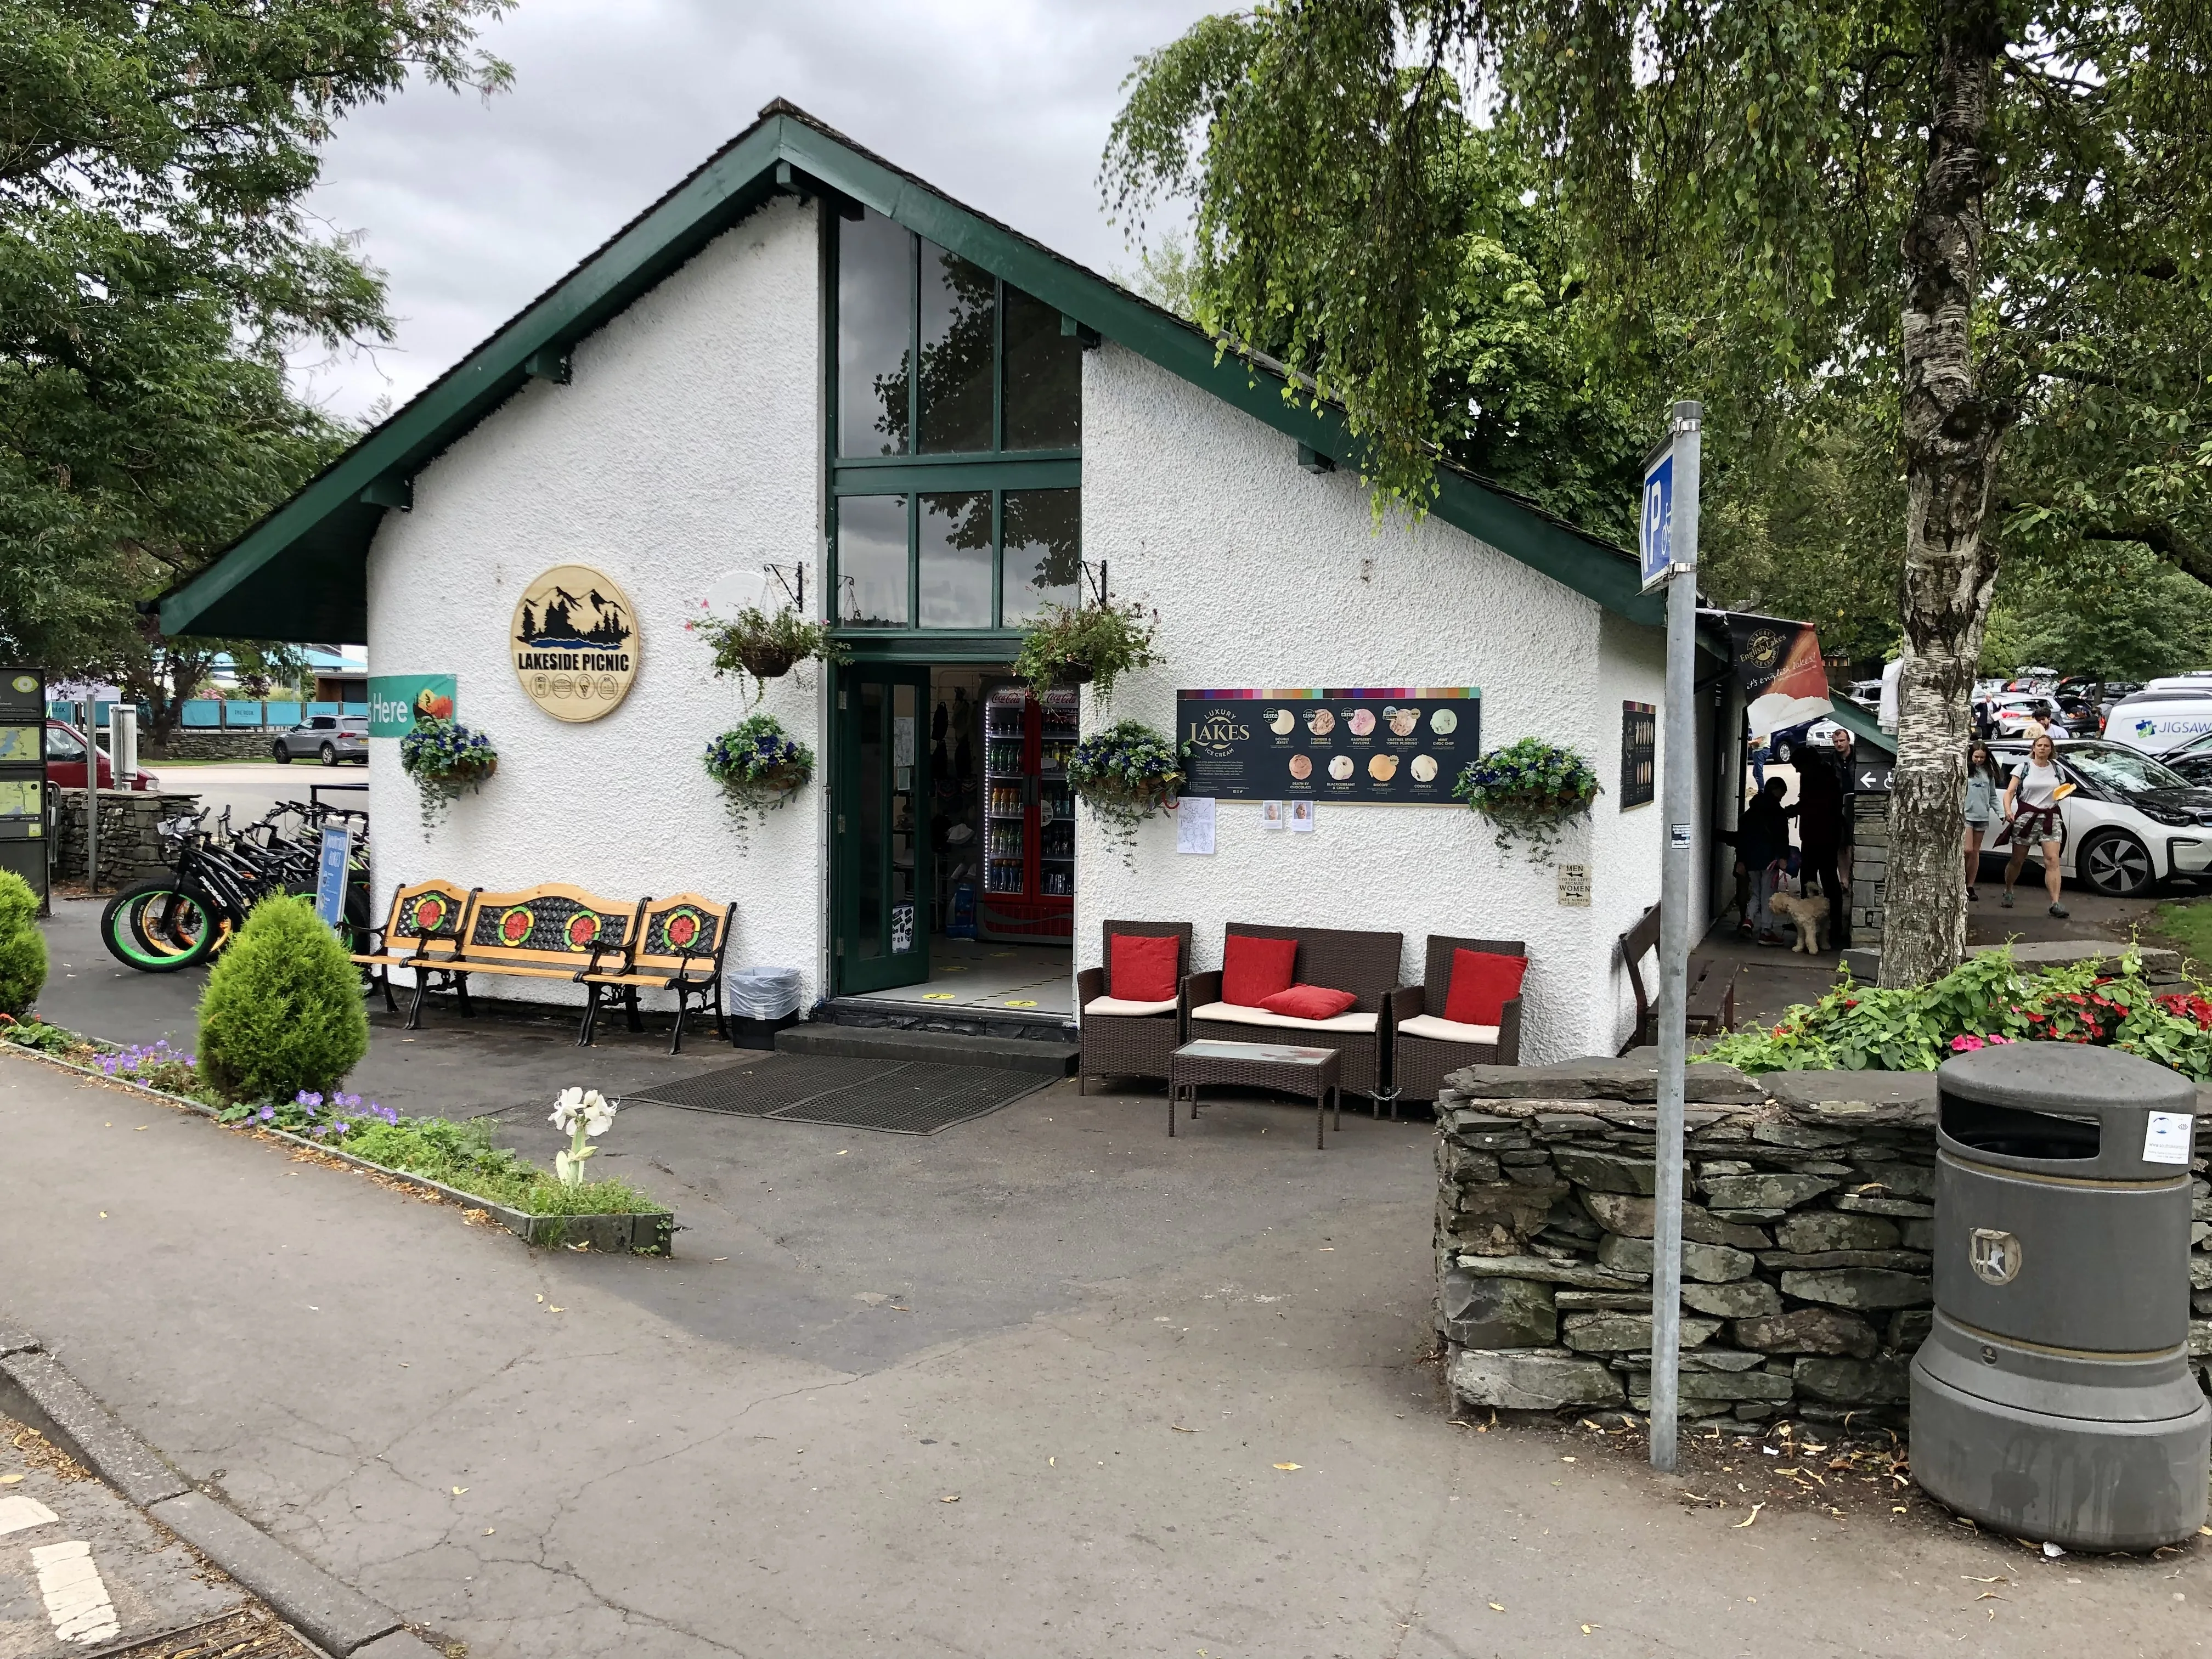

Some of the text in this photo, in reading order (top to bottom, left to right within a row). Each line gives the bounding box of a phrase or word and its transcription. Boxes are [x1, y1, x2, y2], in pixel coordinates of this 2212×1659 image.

[1649, 479, 1661, 565] P
[1749, 630, 1770, 645] LUXURY
[1740, 634, 1786, 662] English Lakes
[518, 653, 630, 672] LAKESIDE PICNIC
[1764, 650, 1777, 666] CREAM
[1747, 678, 1758, 690] it's
[1759, 665, 1791, 686] english
[992, 692, 1021, 704] Coca-Cola
[1047, 692, 1076, 704] Coca-Cola
[373, 692, 408, 723] Here
[1204, 708, 1237, 720] LUXURY
[1190, 723, 1250, 747] LAKES
[2159, 721, 2212, 733] JIGSAW
[1205, 747, 1234, 757] ICE CREAM
[199, 876, 227, 907] PEDEGO
